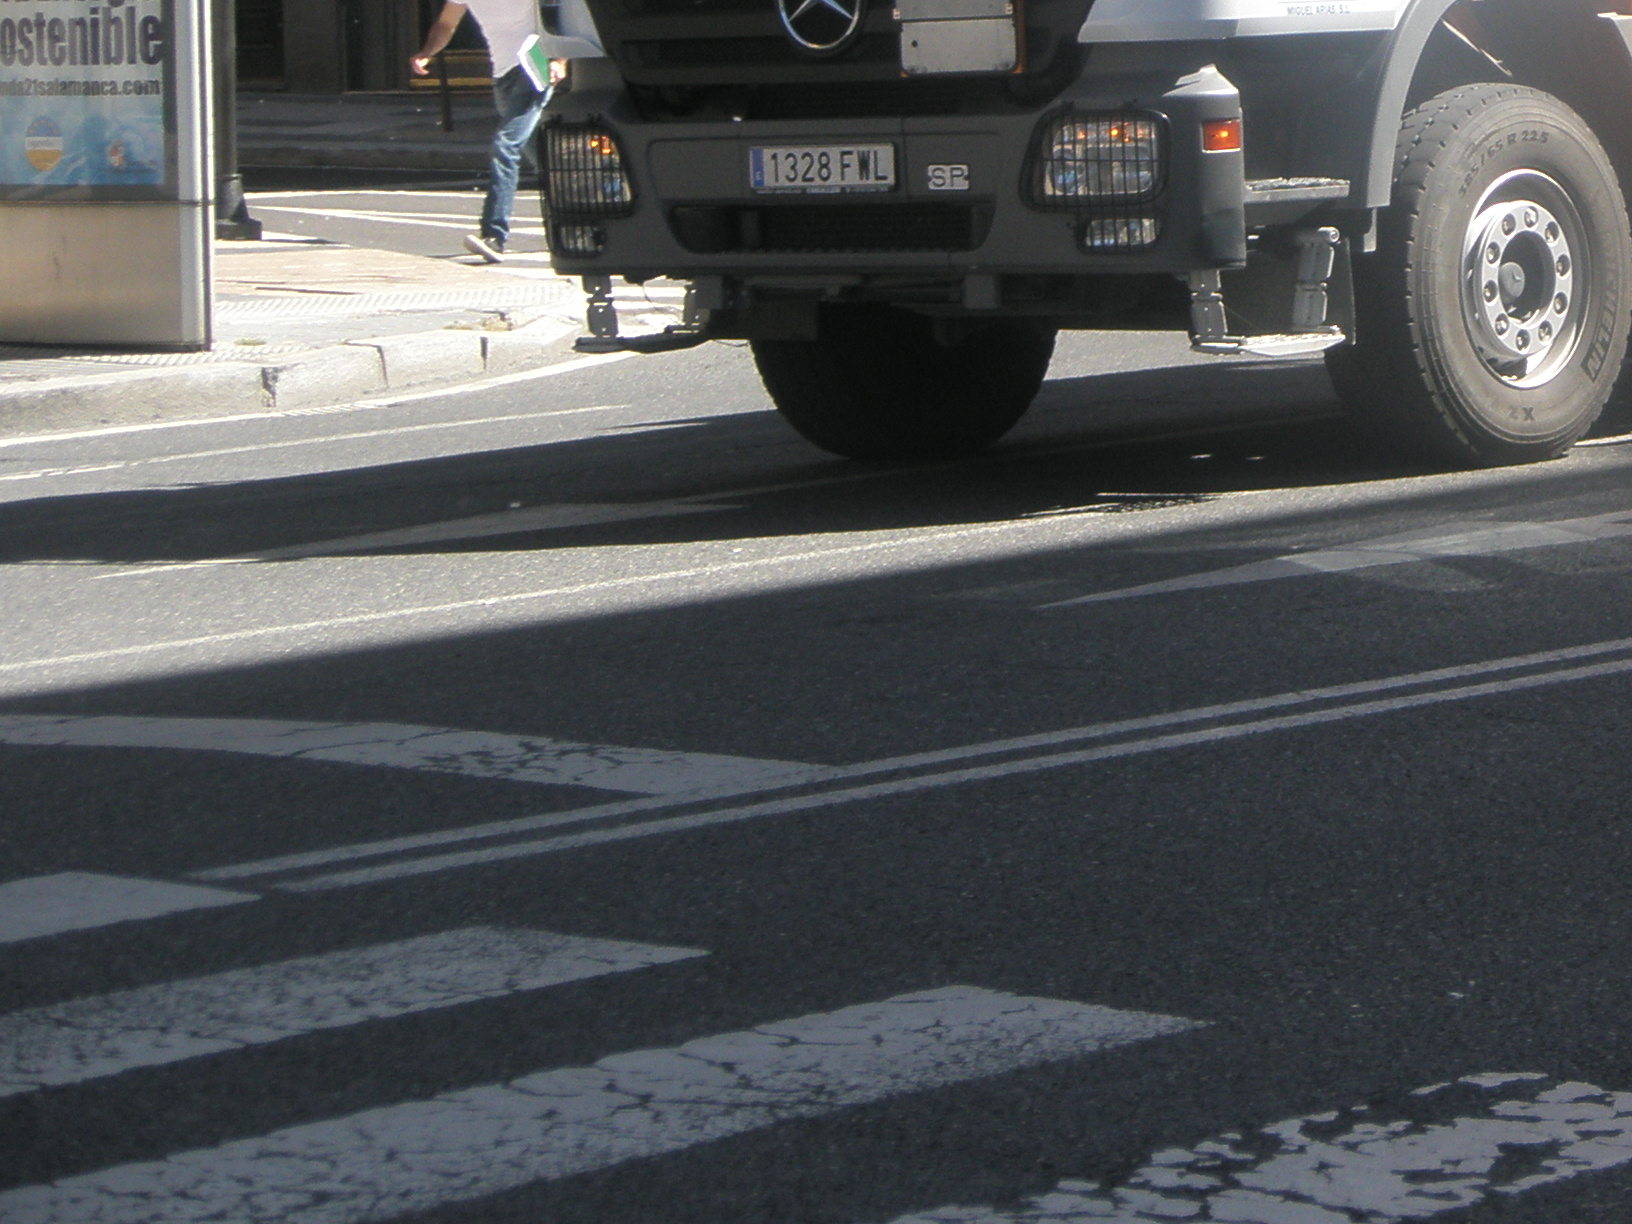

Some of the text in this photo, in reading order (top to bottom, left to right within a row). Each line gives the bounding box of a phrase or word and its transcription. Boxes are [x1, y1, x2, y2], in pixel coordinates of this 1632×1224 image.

[0, 6, 163, 66] ostenible
[771, 150, 888, 182] 1328 FWL
[931, 167, 965, 187] SP
